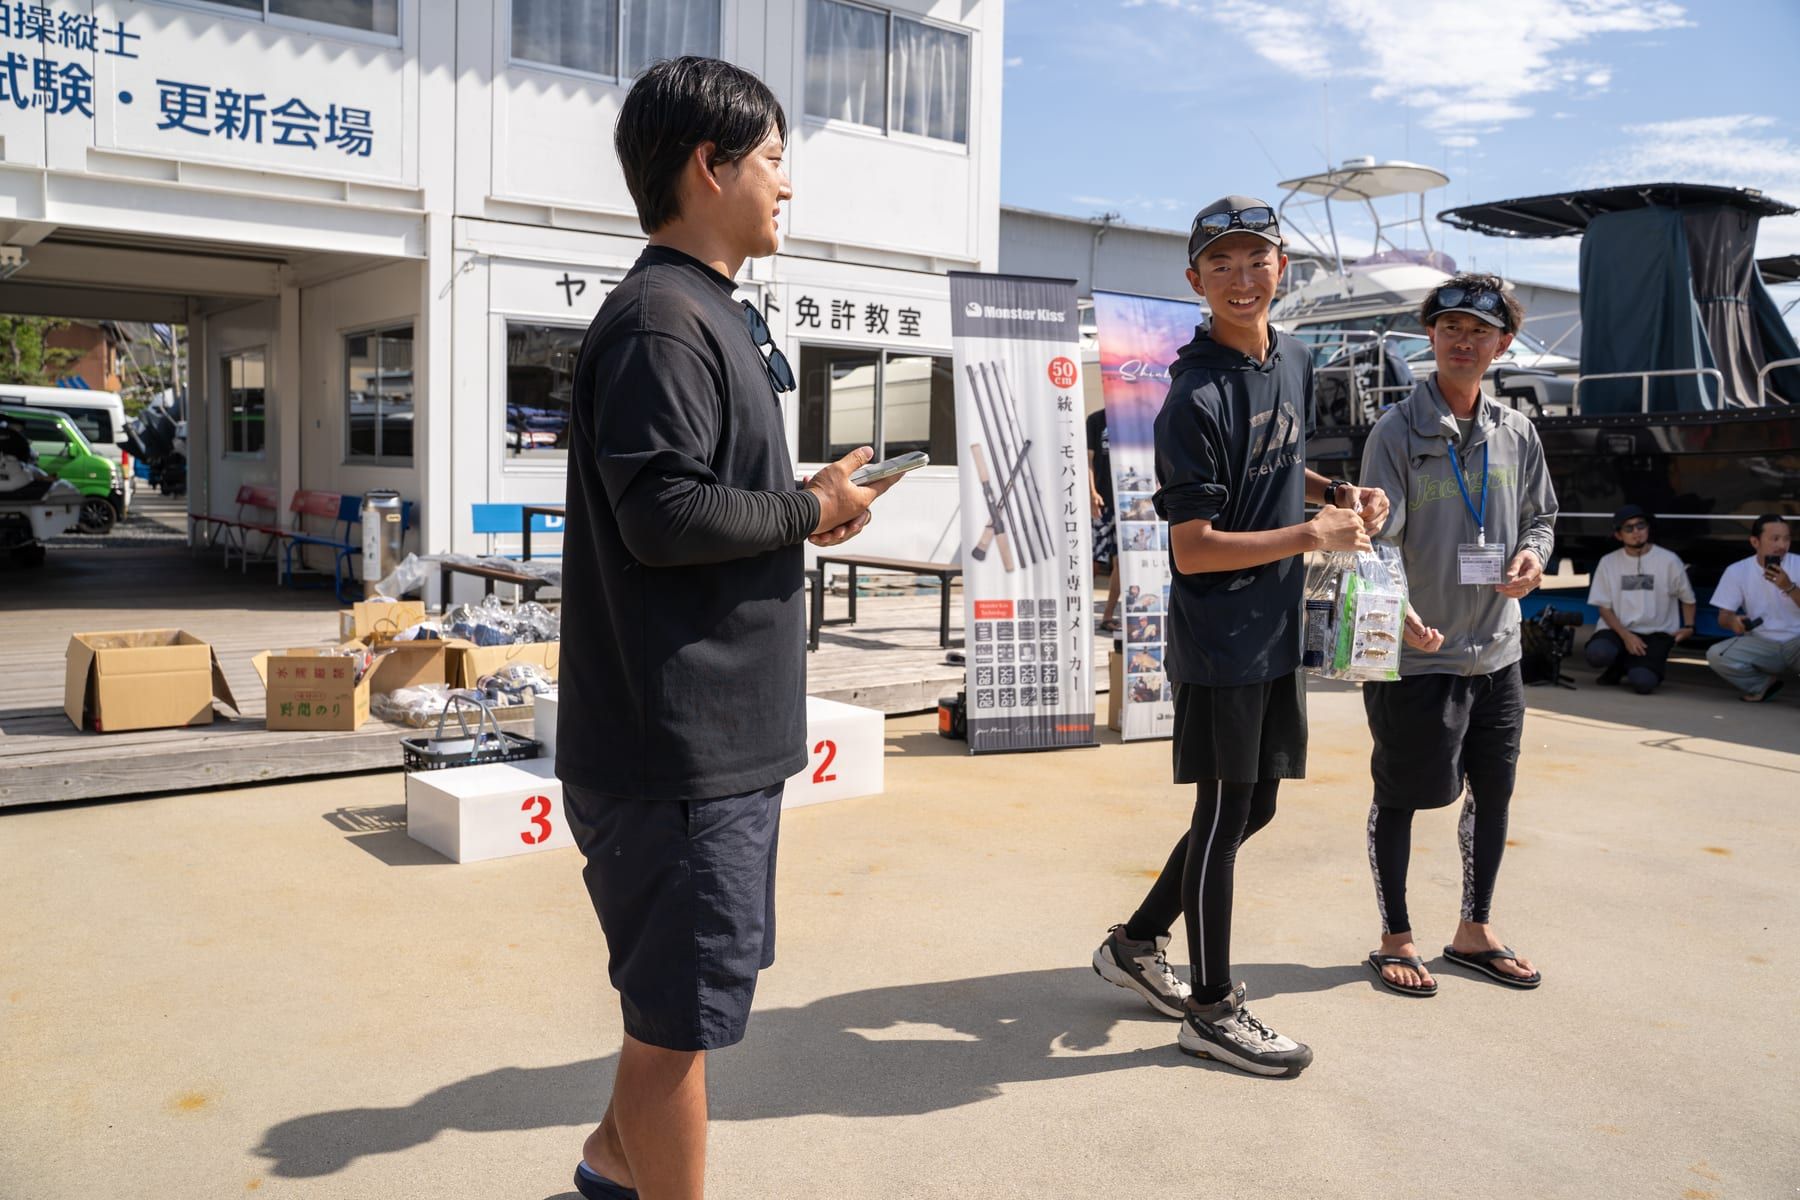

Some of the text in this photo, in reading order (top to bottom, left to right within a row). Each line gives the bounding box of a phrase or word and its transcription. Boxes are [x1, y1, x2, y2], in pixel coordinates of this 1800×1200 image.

[0, 1, 141, 59] 操縦士
[984, 306, 1065, 323] Monster Kiss
[1052, 361, 1074, 377] 50
[1055, 376, 1072, 385] cm
[1408, 464, 1518, 511] Jacson
[812, 740, 836, 784] 2
[520, 795, 552, 845] 3
